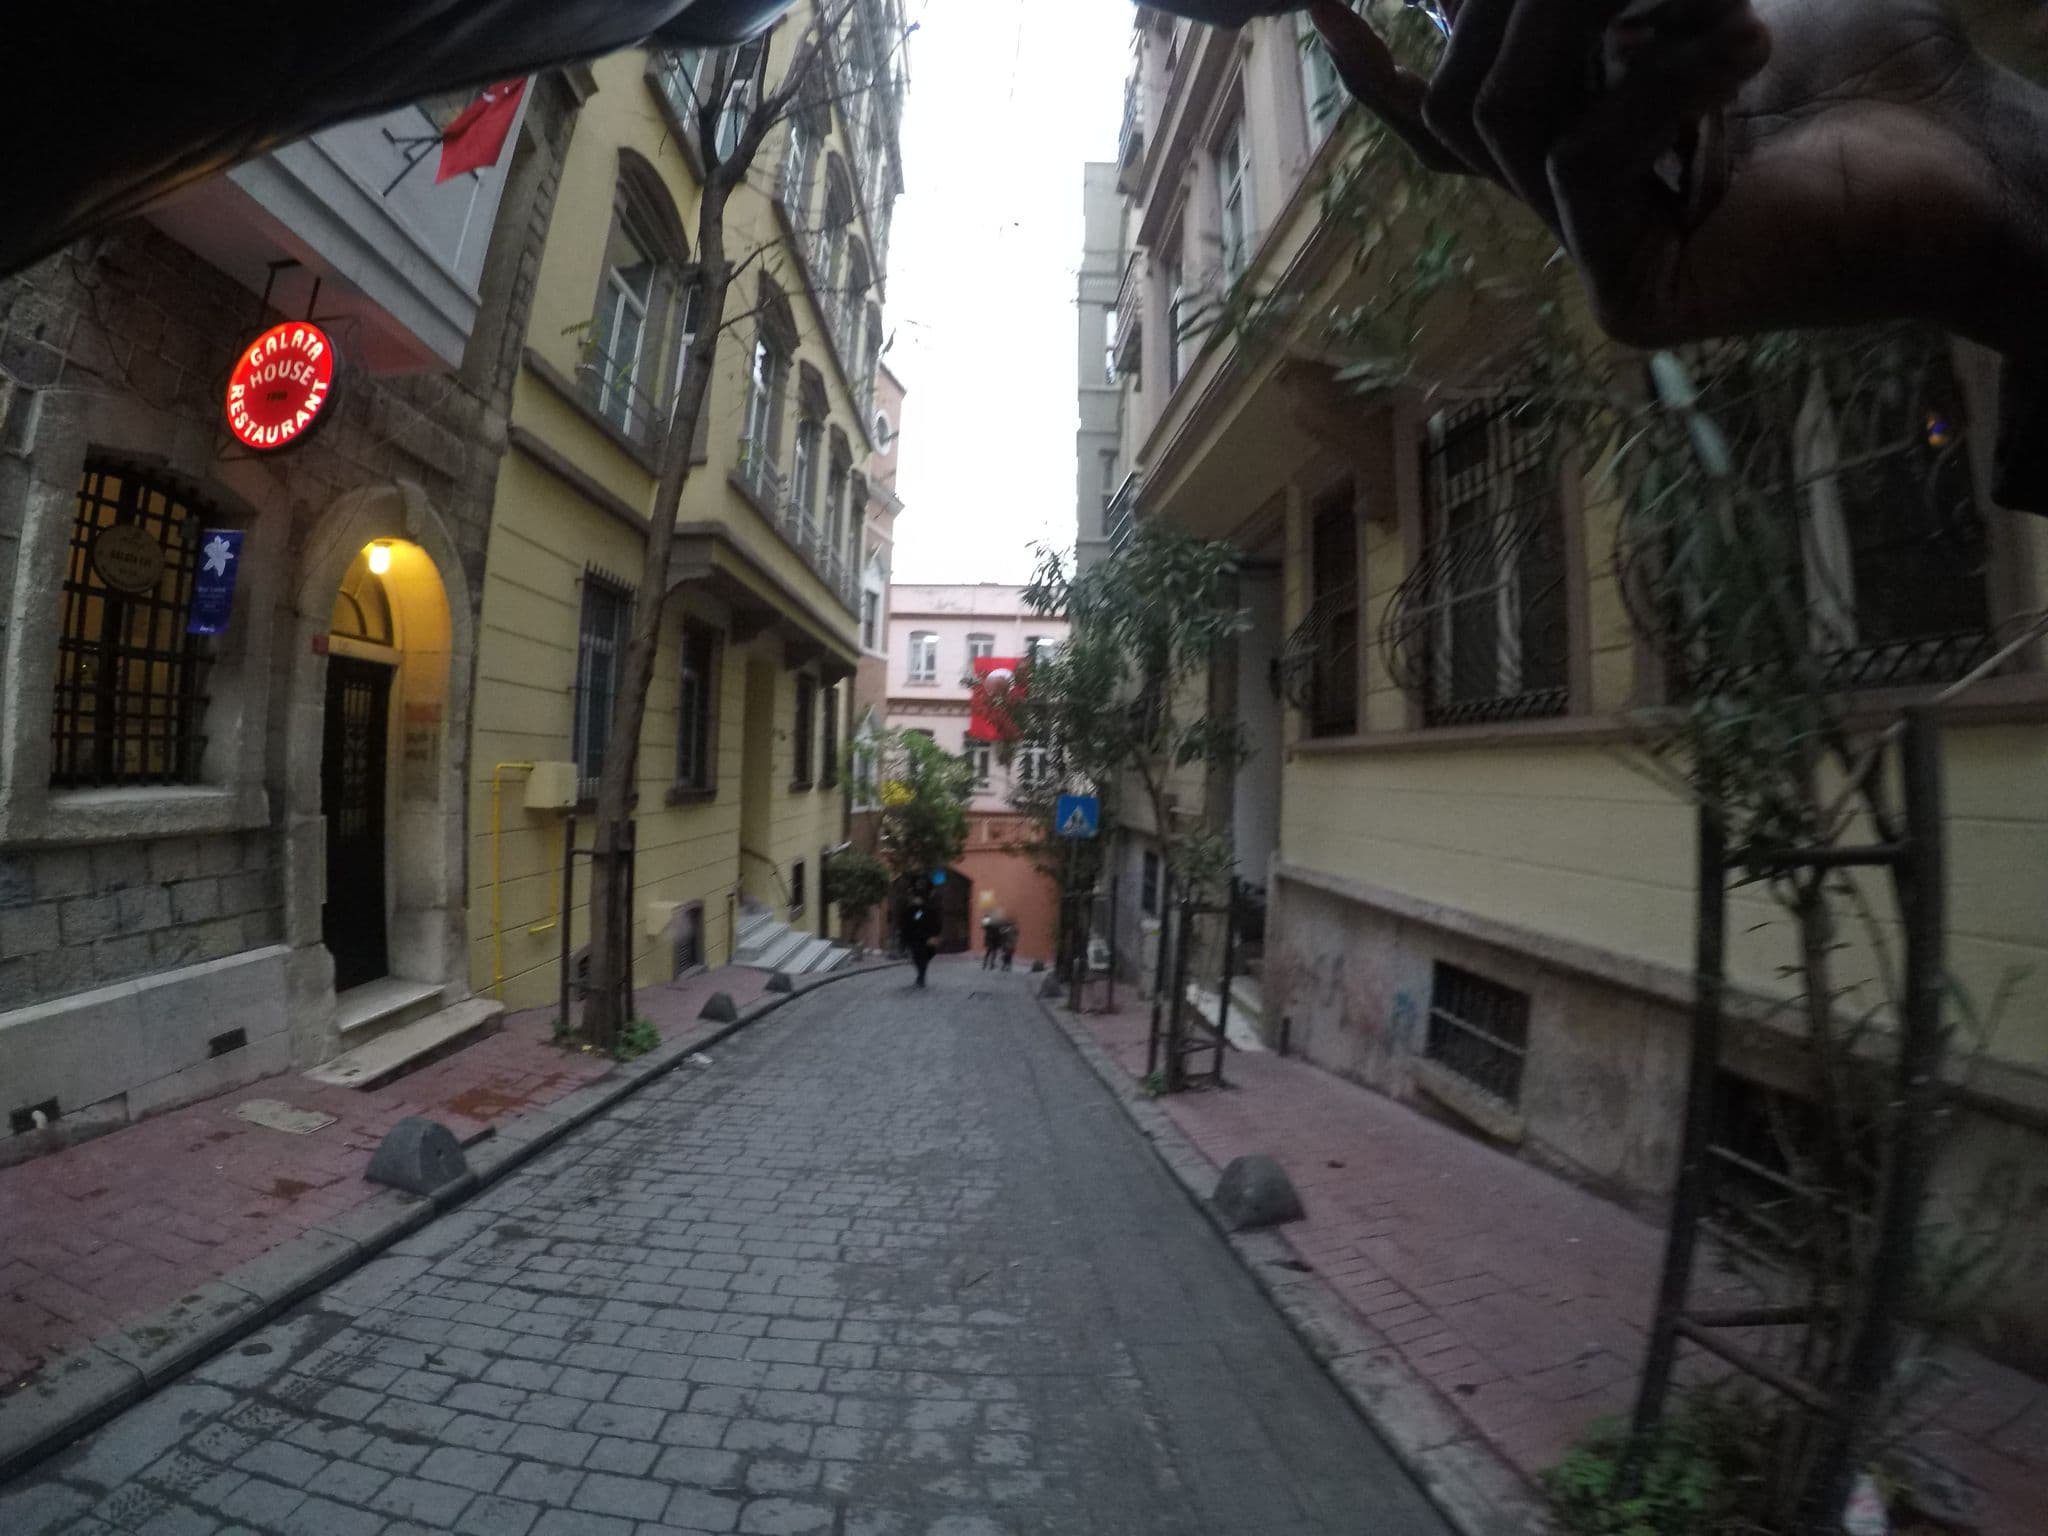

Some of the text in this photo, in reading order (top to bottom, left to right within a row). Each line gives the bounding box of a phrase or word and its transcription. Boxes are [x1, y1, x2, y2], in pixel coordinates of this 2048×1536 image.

[250, 329, 324, 367] GALATA
[250, 359, 315, 389] HOUSE
[230, 378, 328, 444] RESTAURANT
